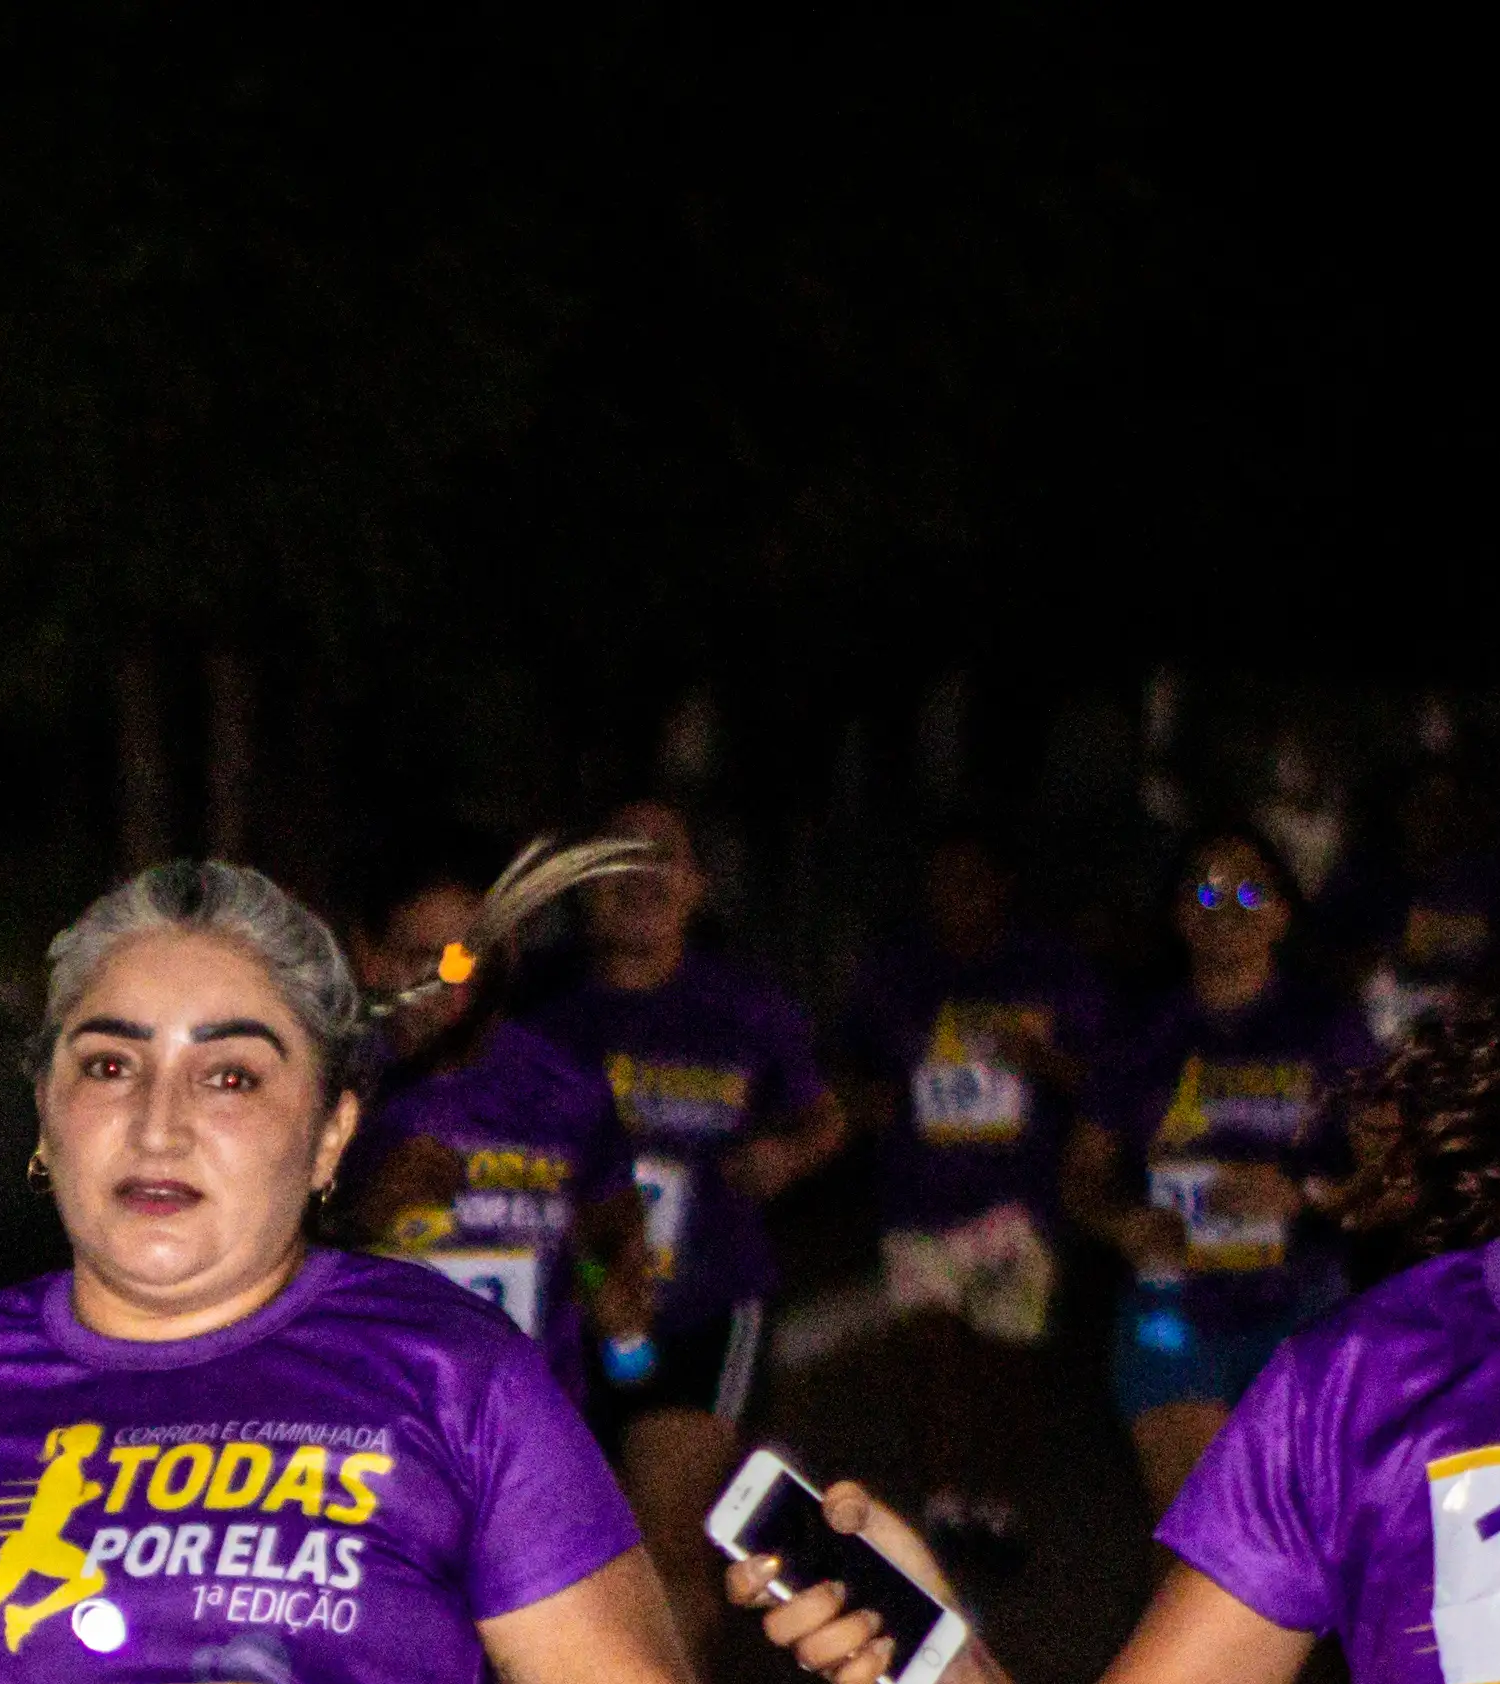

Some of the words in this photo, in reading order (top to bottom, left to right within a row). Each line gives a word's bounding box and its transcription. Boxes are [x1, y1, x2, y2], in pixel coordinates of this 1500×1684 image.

[113, 1422, 218, 1446] CORRIDA
[220, 1420, 240, 1441] E
[240, 1420, 389, 1451] CAMINHADA
[104, 1441, 395, 1525] TODAS
[80, 1523, 213, 1579] POR
[215, 1524, 366, 1589] ELAS
[227, 1585, 359, 1635] EDIÇÃO
